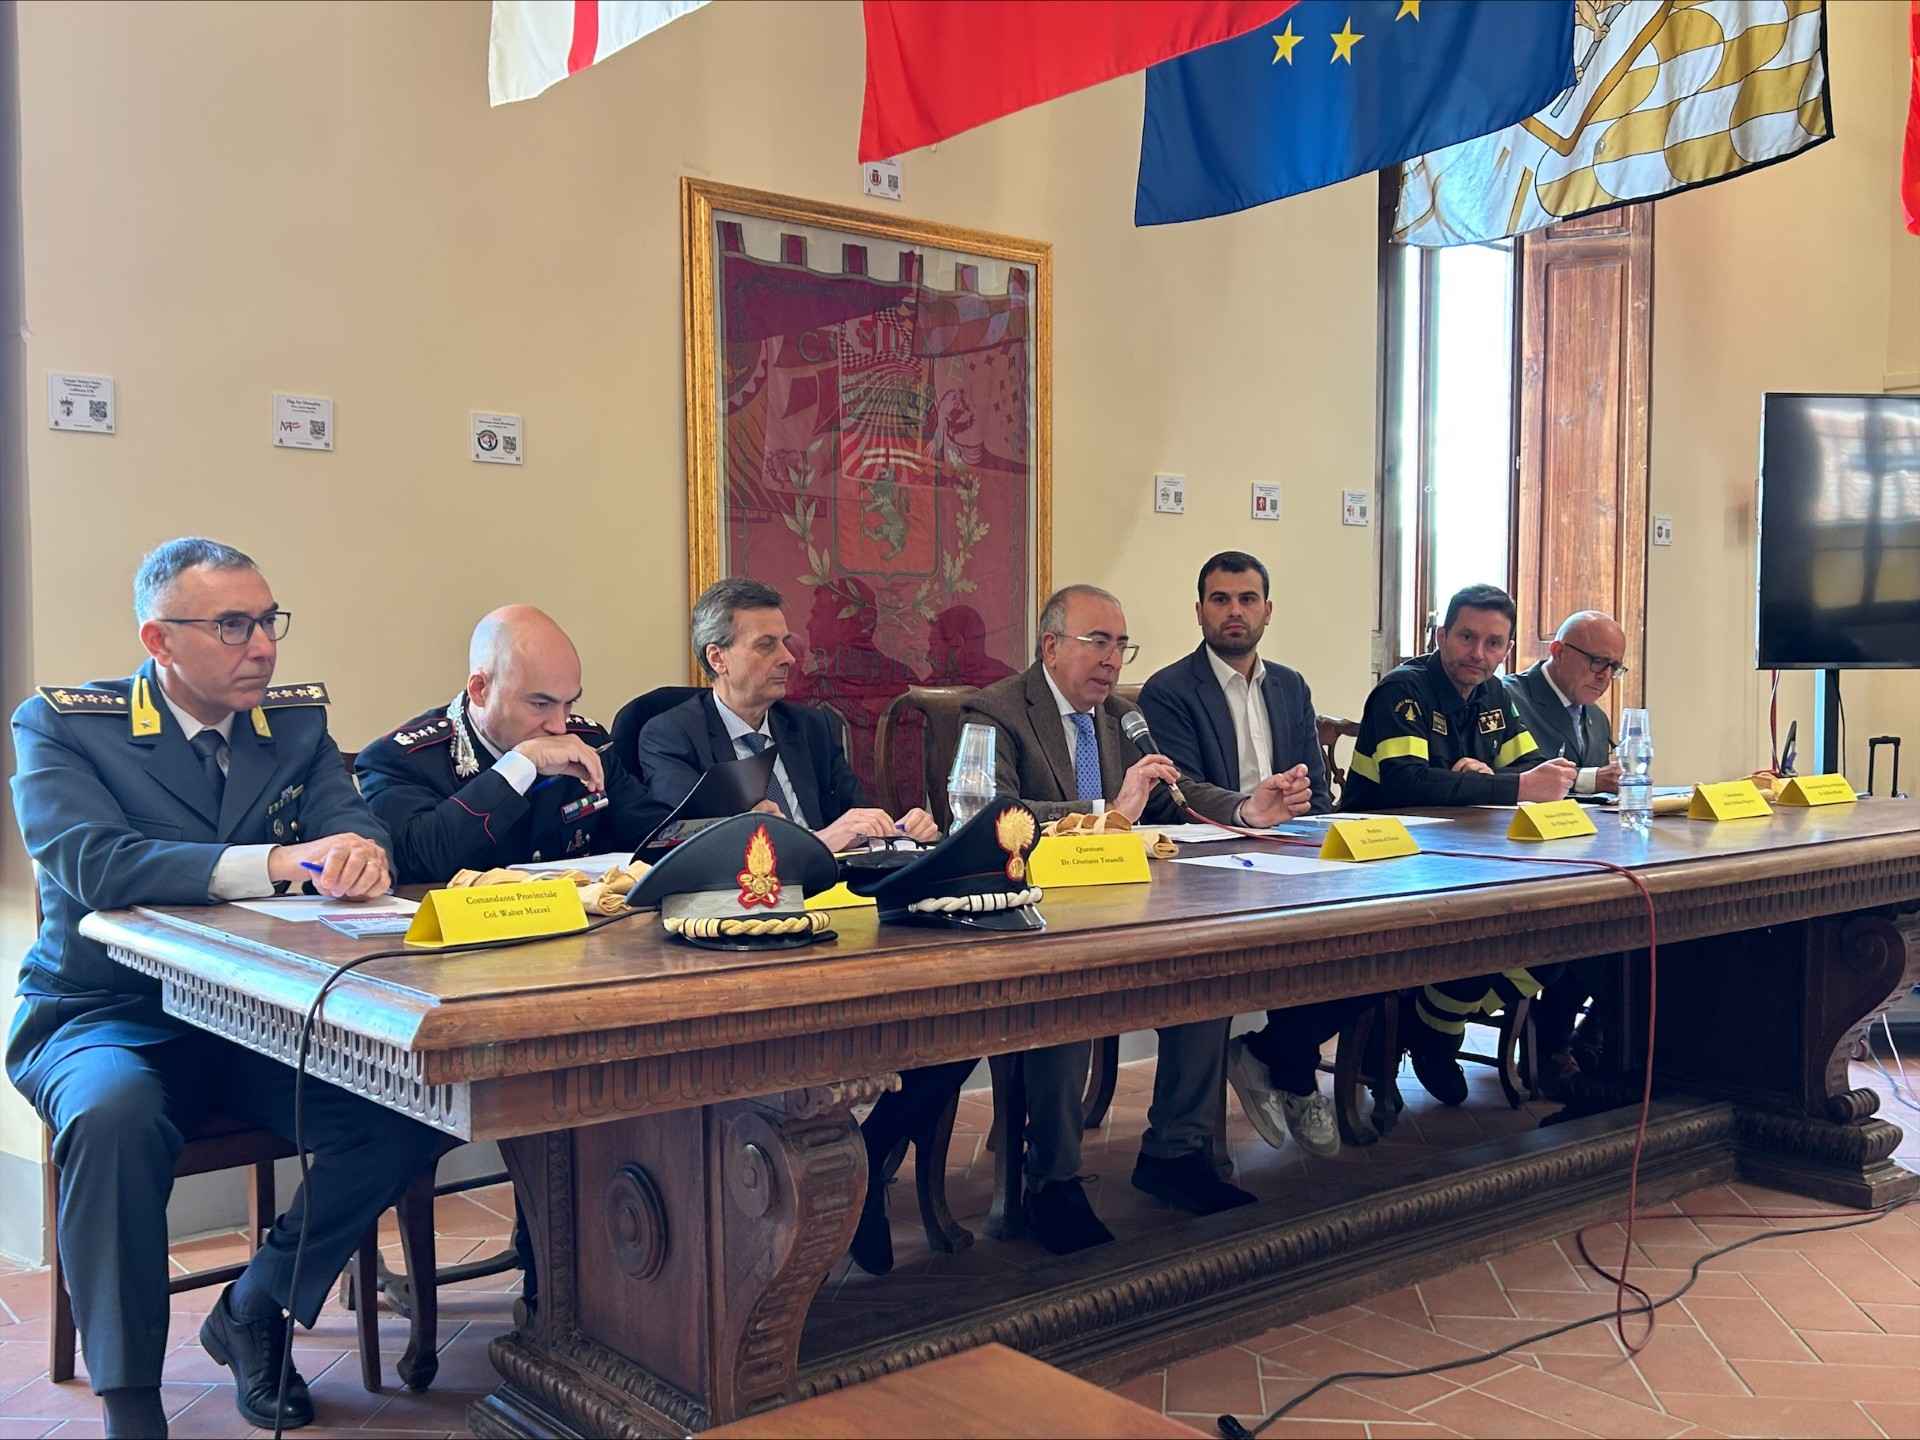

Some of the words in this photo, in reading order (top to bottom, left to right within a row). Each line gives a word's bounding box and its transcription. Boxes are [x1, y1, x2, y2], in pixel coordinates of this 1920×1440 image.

[813, 648, 962, 681] BIBBIENA
[466, 894, 516, 905] Comandante
[516, 890, 558, 900] Provinciale
[483, 910, 499, 919] Col.
[500, 908, 524, 918] Walter
[525, 906, 551, 915] Mazzei
